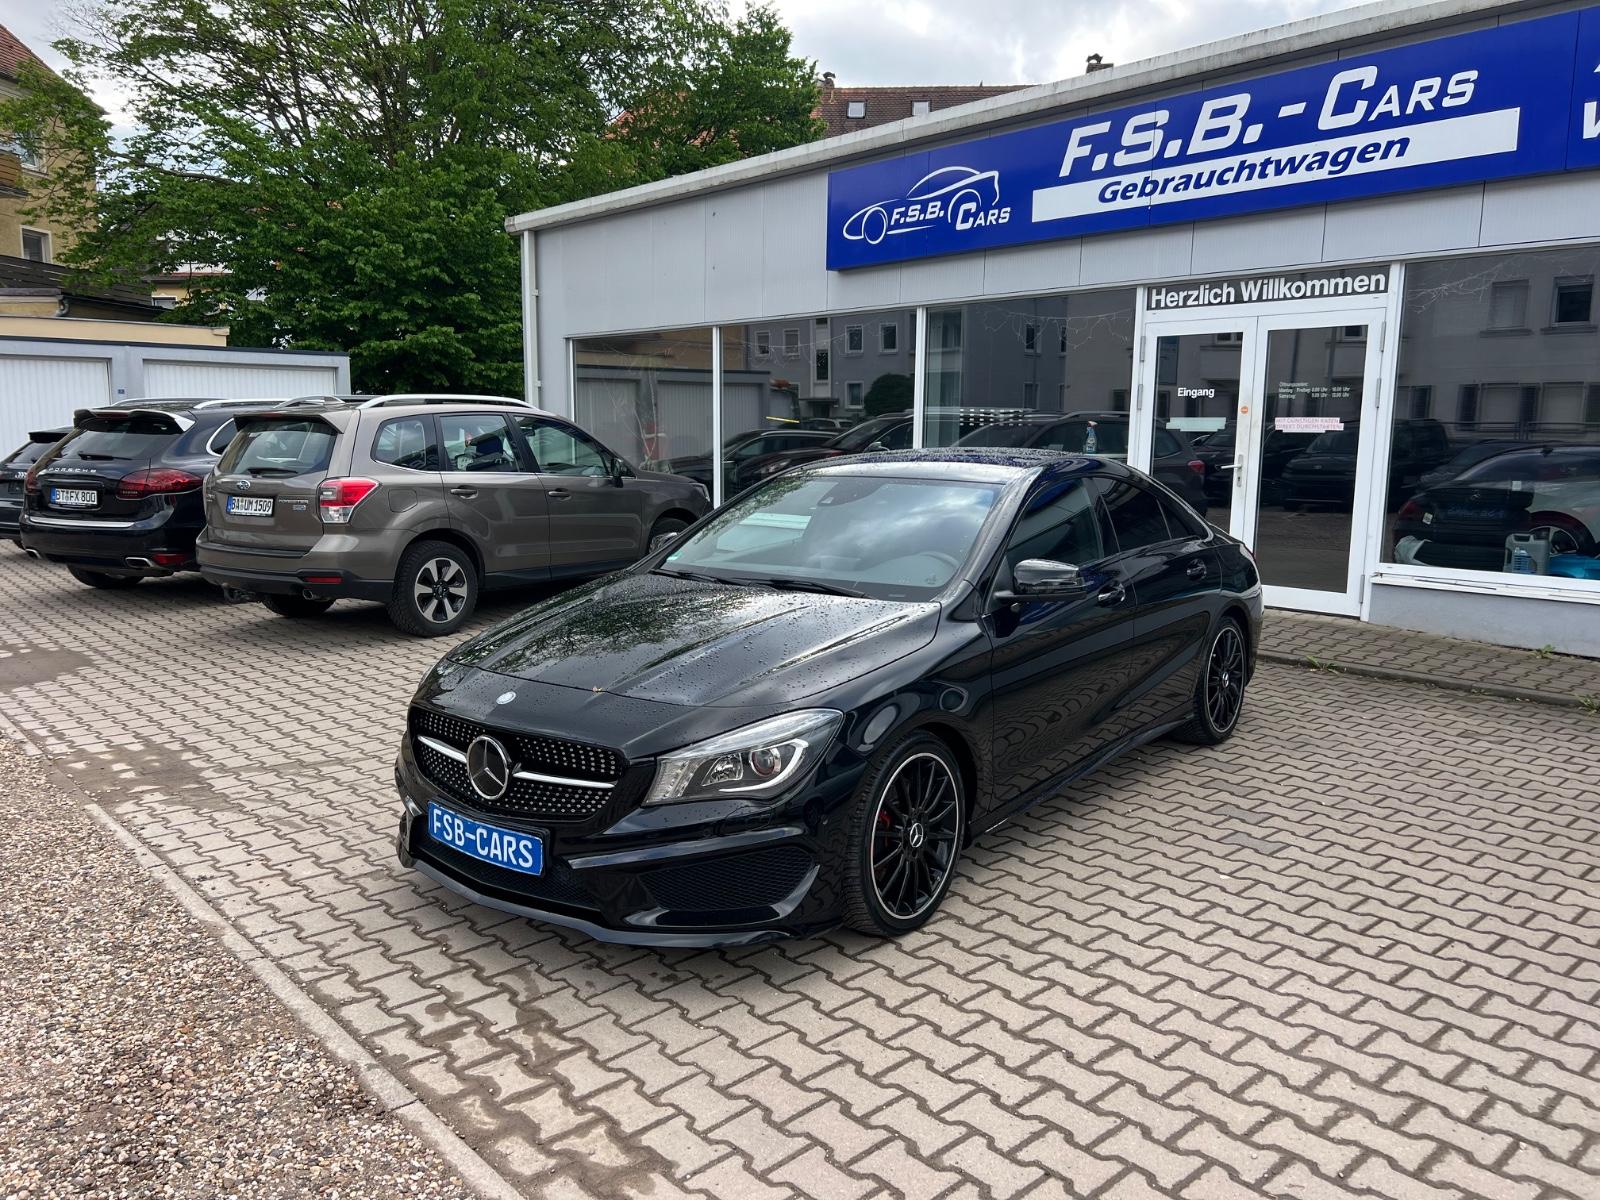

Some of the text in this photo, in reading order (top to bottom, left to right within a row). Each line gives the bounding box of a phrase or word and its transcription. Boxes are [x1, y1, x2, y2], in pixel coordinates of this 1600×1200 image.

[1058, 92, 1264, 178] F.S.B.
[1097, 136, 1411, 203] Gebrauchtwagen
[890, 201, 944, 226] F.S.B.
[1150, 272, 1386, 309] Herzlich Willkommen
[1177, 387, 1215, 399] Eingang
[56, 489, 96, 503] BT FX 800
[254, 499, 272, 513] 1509
[432, 808, 534, 869] FSB-CARS
